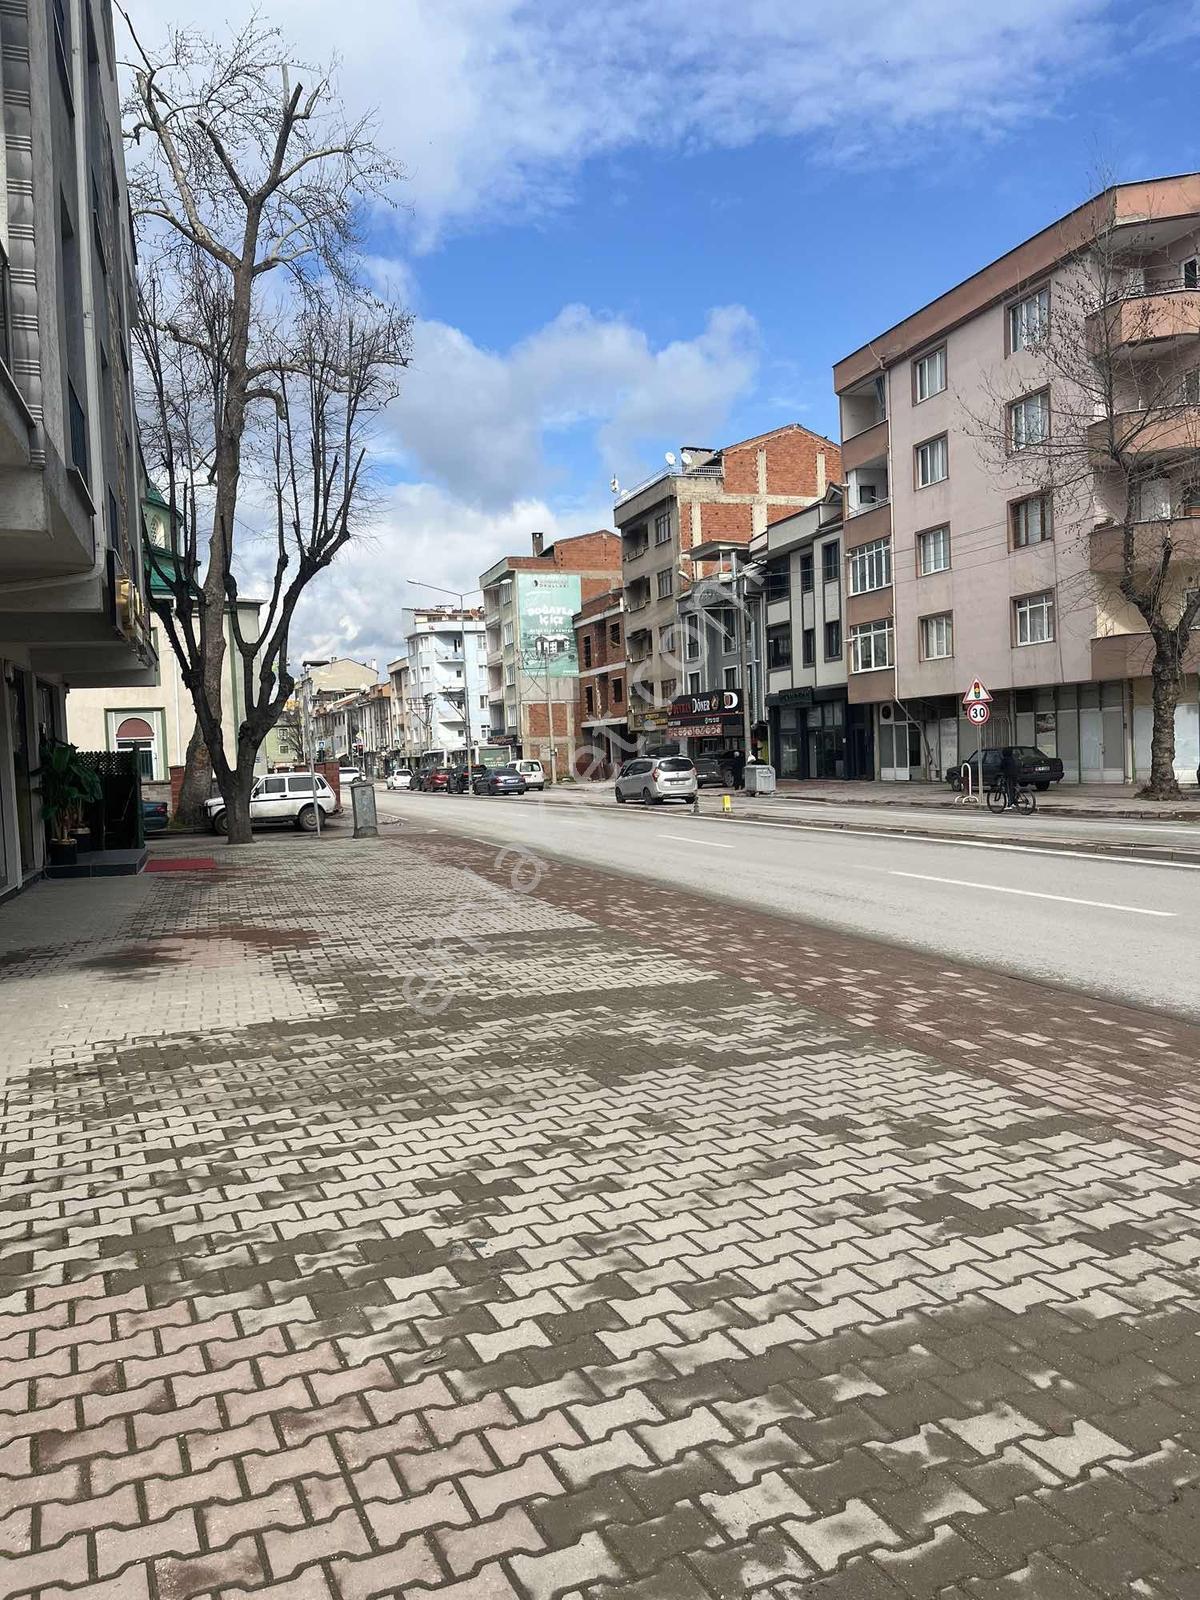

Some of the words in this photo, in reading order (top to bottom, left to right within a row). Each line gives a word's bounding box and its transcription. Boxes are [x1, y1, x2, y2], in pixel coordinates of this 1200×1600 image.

[526, 605, 574, 616] DOĞAYLA
[692, 698, 711, 713] DÖNER
[972, 708, 985, 718] 30
